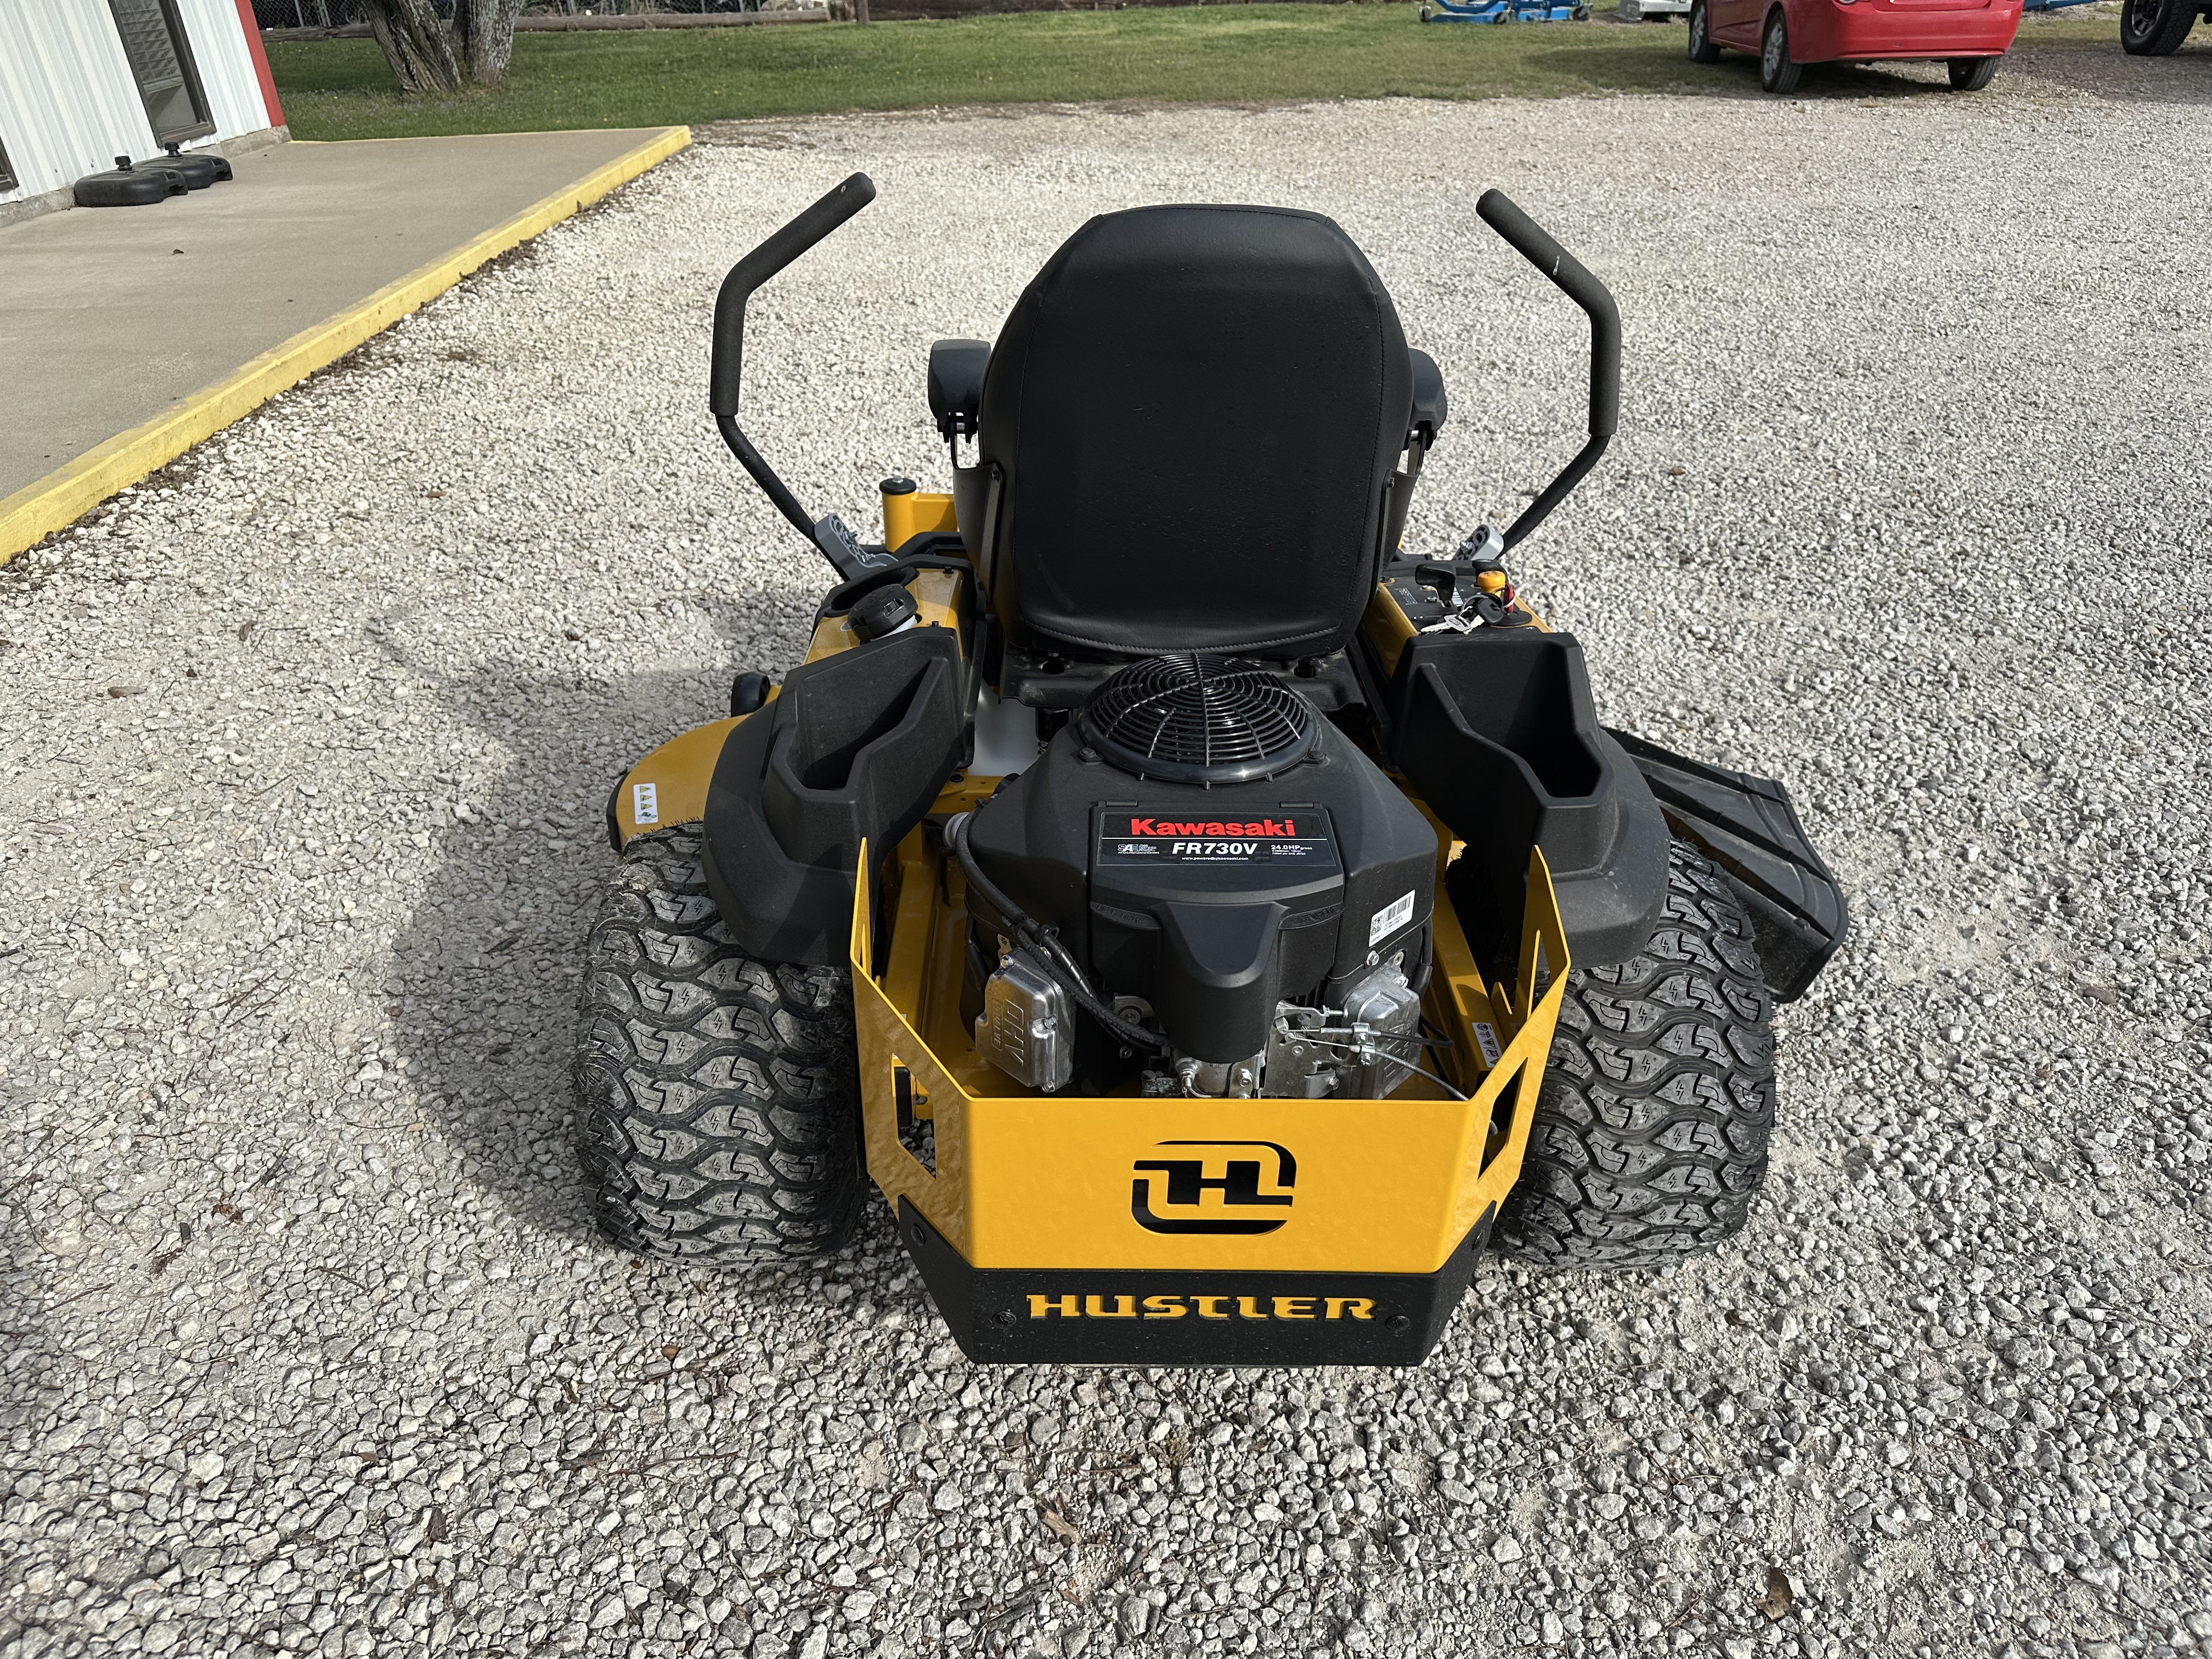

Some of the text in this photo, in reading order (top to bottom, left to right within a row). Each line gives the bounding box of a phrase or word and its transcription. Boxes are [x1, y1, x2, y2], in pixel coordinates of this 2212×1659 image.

[1131, 819, 1295, 836] Kawasaki
[1172, 842, 1258, 855] FR730V
[1004, 999, 1024, 1066] OHV
[1026, 1294, 1378, 1319] HUSTLER
